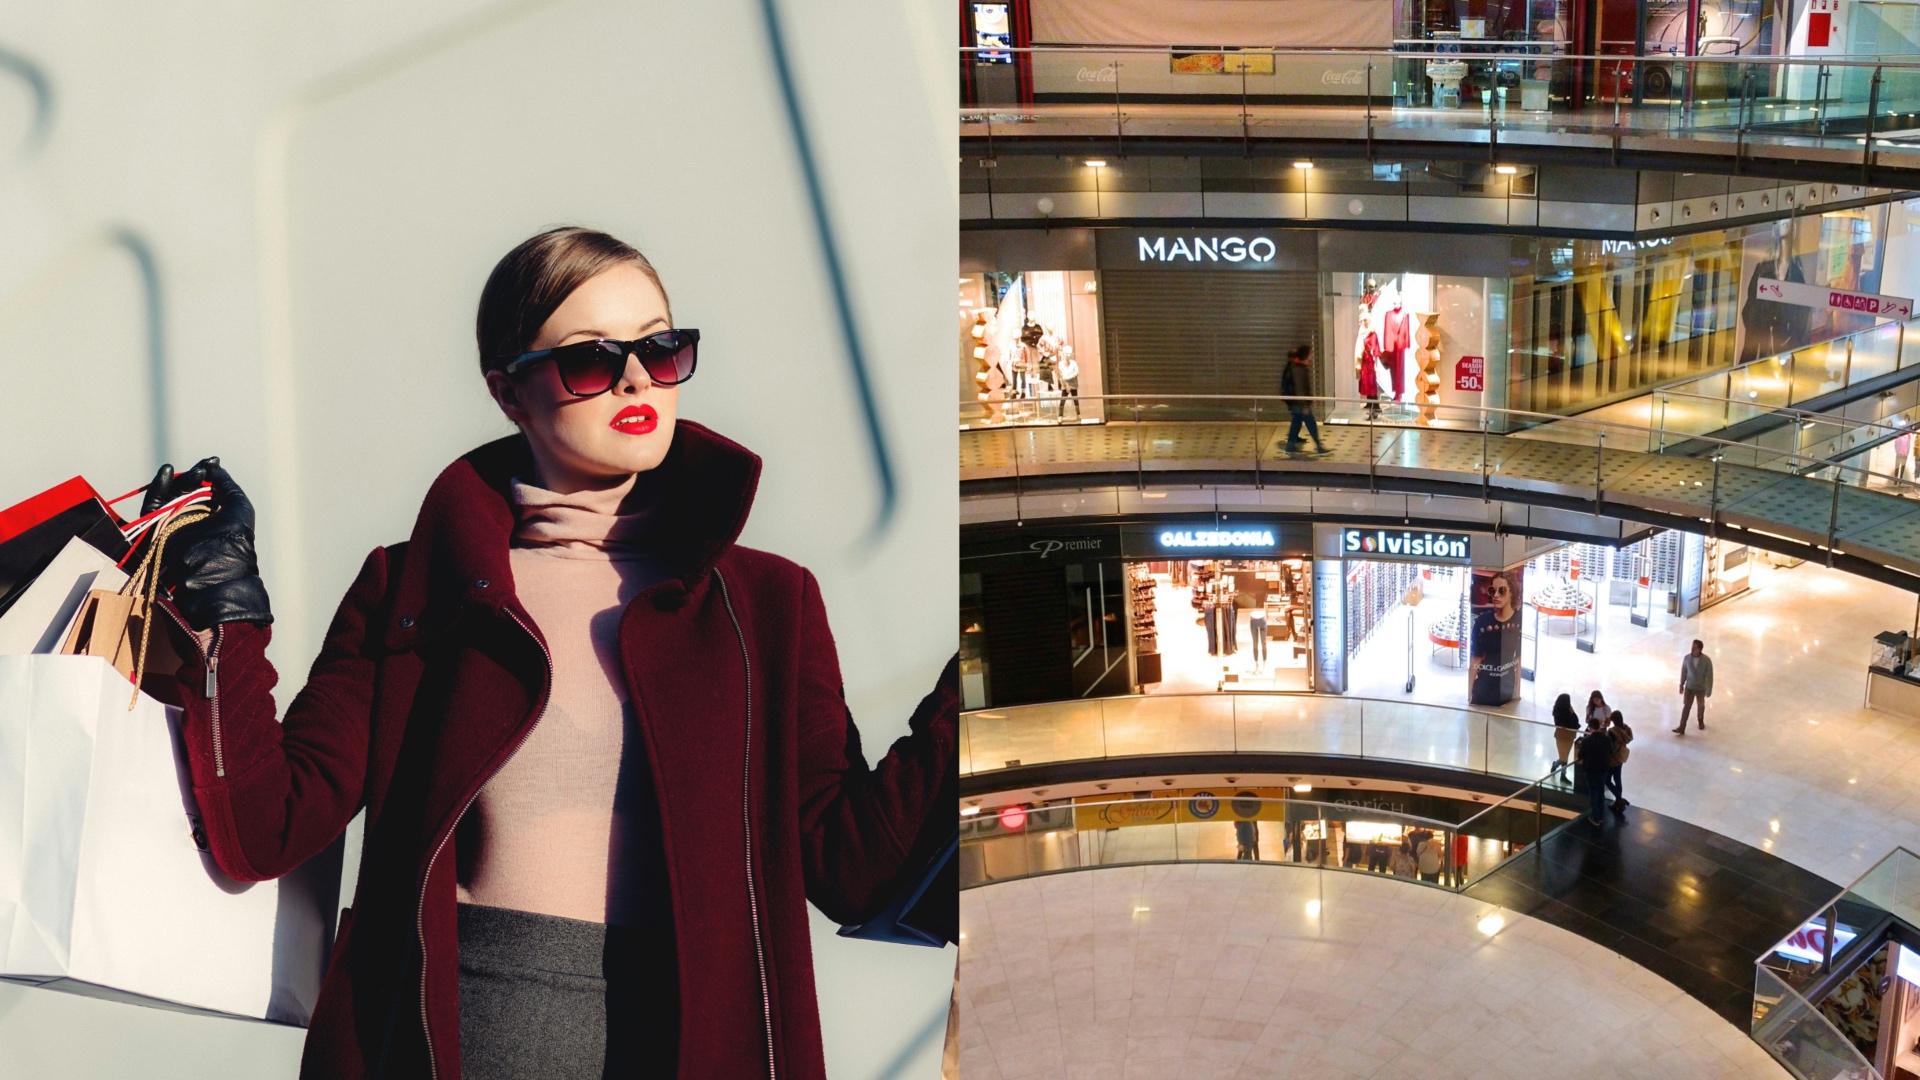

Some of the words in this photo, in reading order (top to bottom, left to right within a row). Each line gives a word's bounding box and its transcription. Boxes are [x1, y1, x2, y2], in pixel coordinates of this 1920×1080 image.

[1138, 236, 1276, 262] MANGO
[1029, 536, 1102, 558] Premier
[1160, 531, 1275, 547] CALZEDONIA
[1473, 664, 1493, 672] DOLCE
